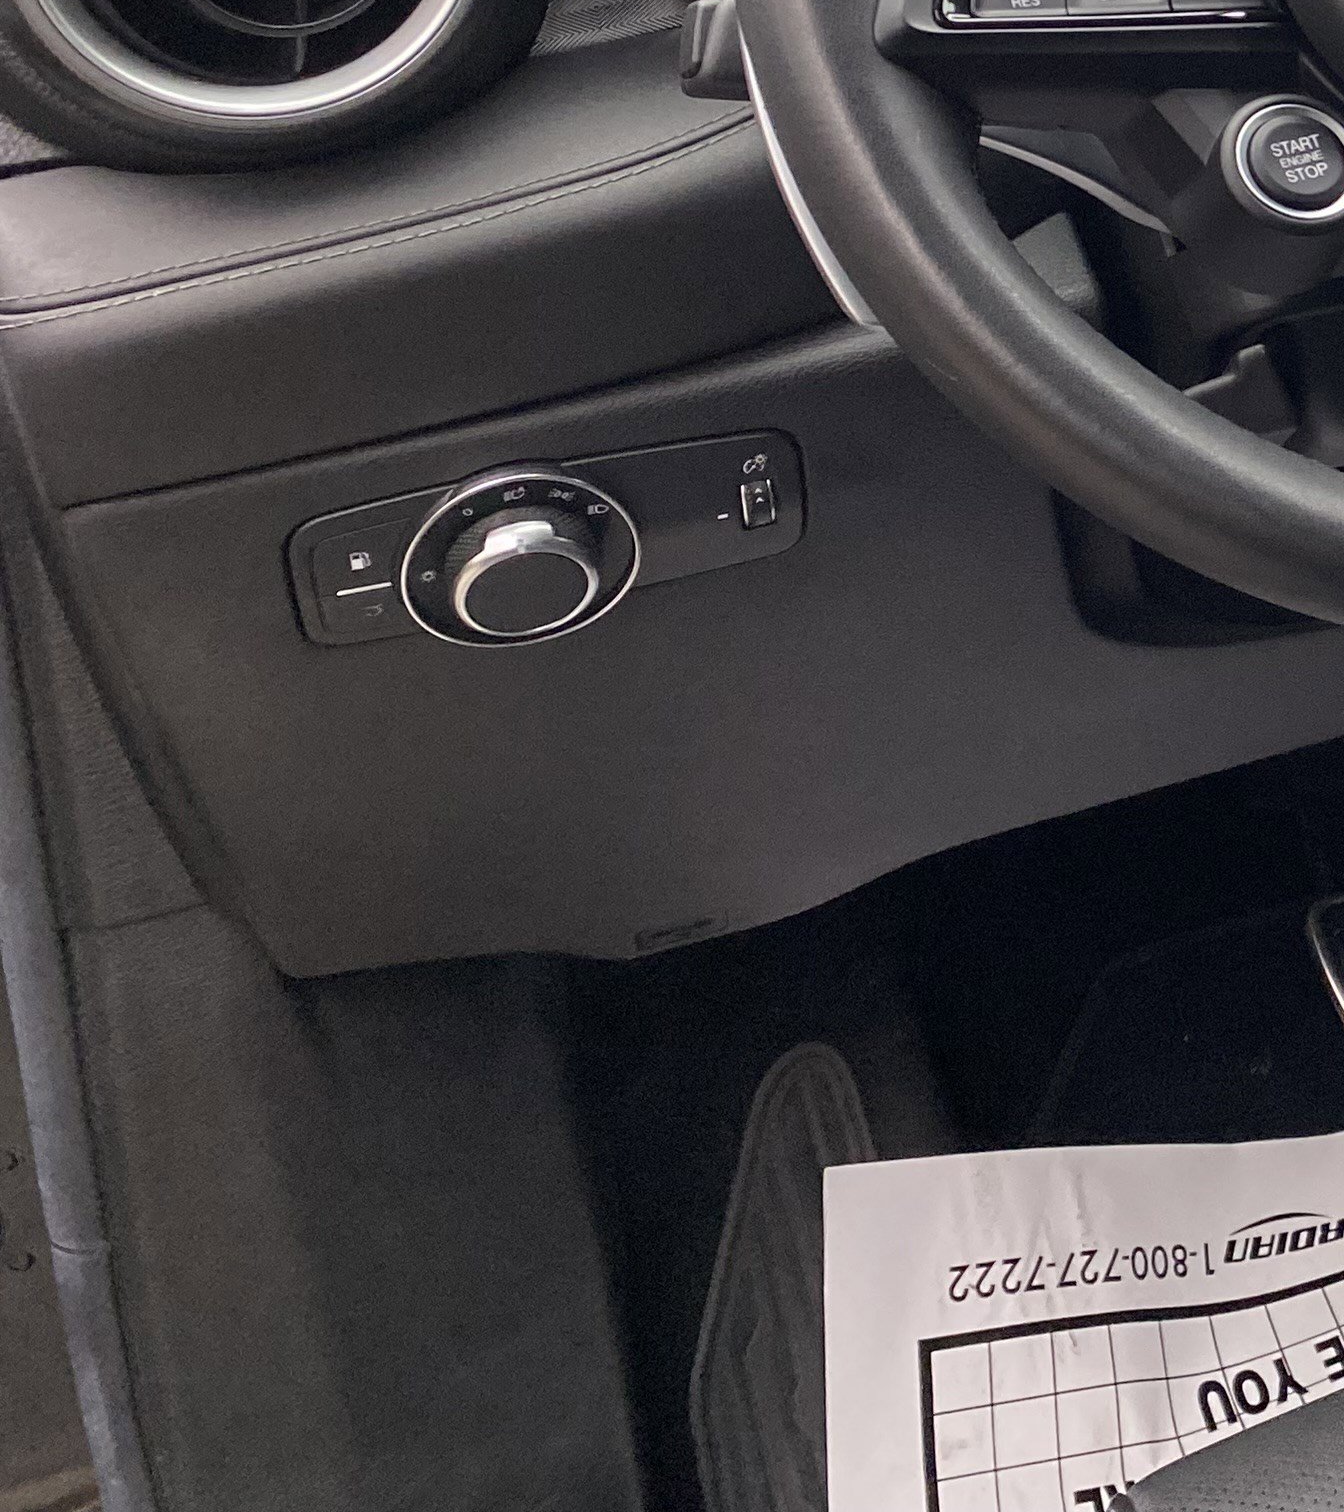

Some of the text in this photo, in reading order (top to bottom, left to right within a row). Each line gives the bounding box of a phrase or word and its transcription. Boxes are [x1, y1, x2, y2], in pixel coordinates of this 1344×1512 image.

[1270, 133, 1319, 157] START
[1279, 149, 1324, 168] ENGINE
[1285, 162, 1328, 183] STOP
[948, 1242, 1215, 1302] 1-800-727-7222
[1198, 1356, 1308, 1433] YOU
